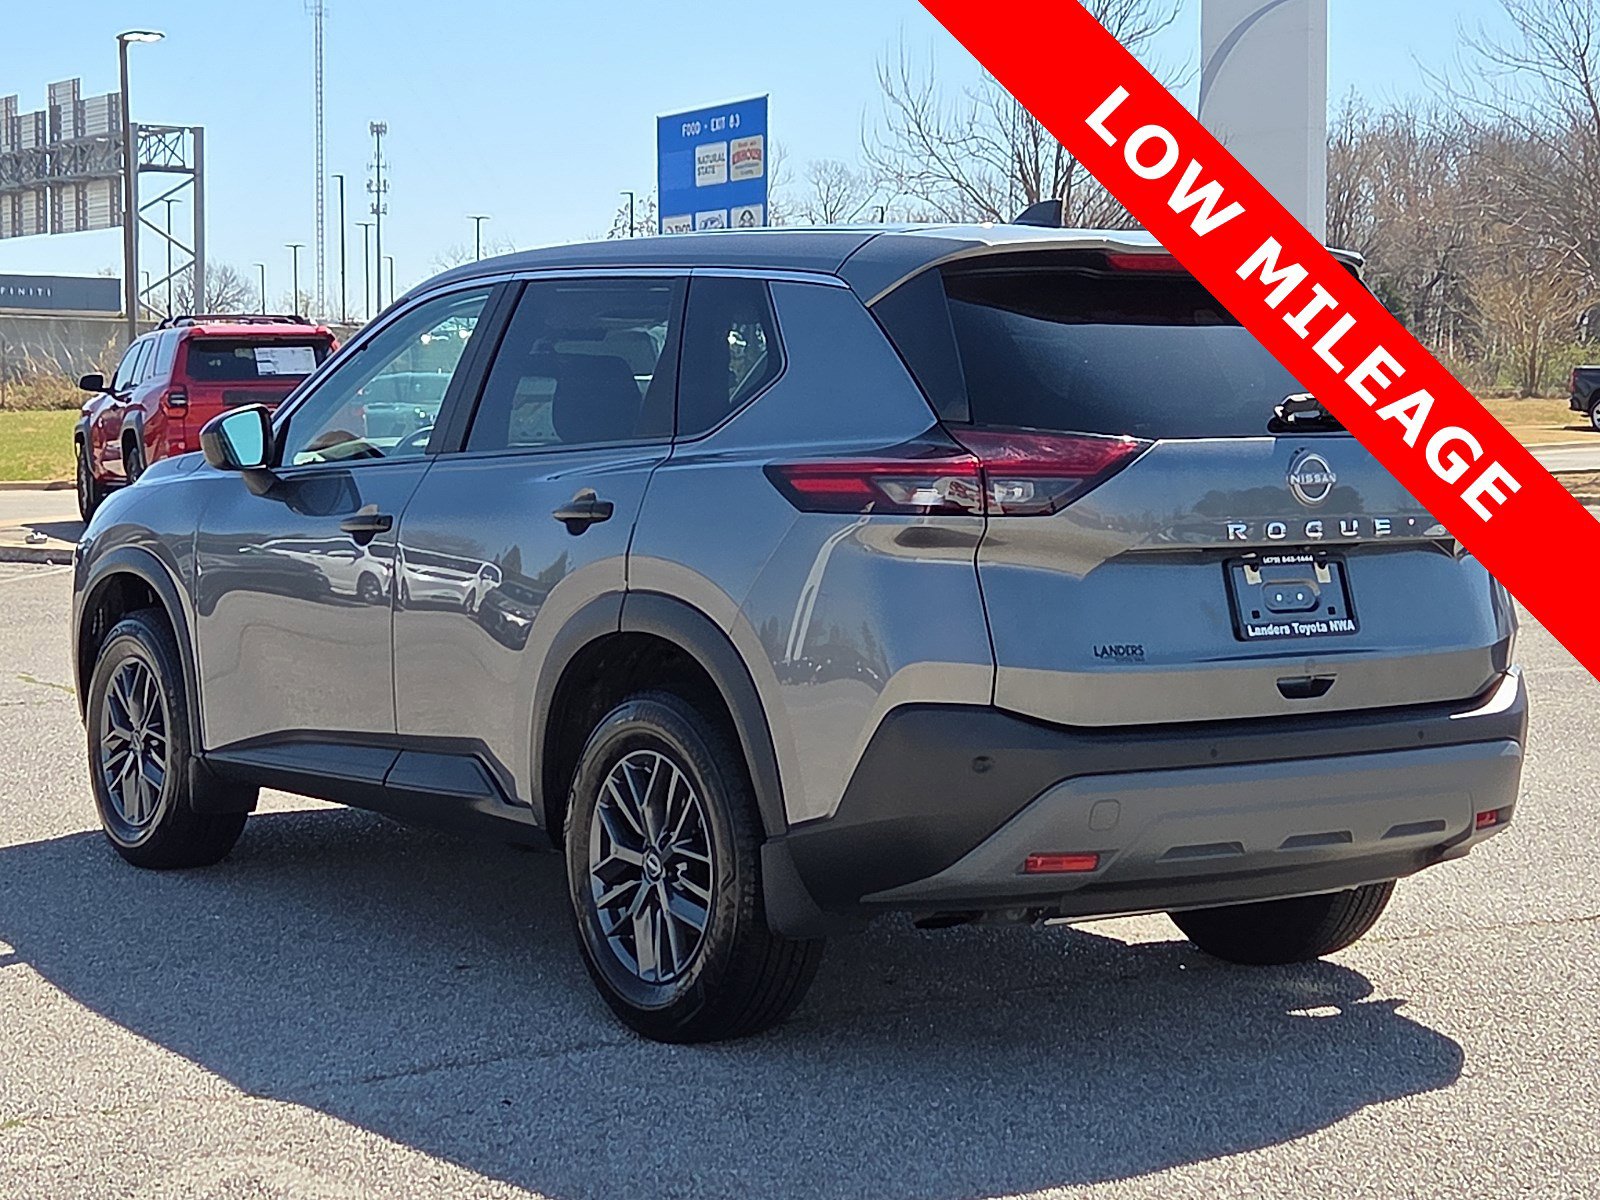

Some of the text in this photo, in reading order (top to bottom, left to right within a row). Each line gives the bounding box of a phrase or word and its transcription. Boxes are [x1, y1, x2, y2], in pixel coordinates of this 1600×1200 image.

[682, 120, 702, 137] FOOD
[710, 116, 726, 132] EXIT
[697, 152, 726, 165] NATURAL
[697, 164, 716, 177] STATE
[1290, 473, 1337, 484] NISSAN
[1226, 518, 1391, 541] ROGUE
[1247, 619, 1356, 637] Landers Toyota NWA
[1093, 644, 1144, 658] LANDERS
